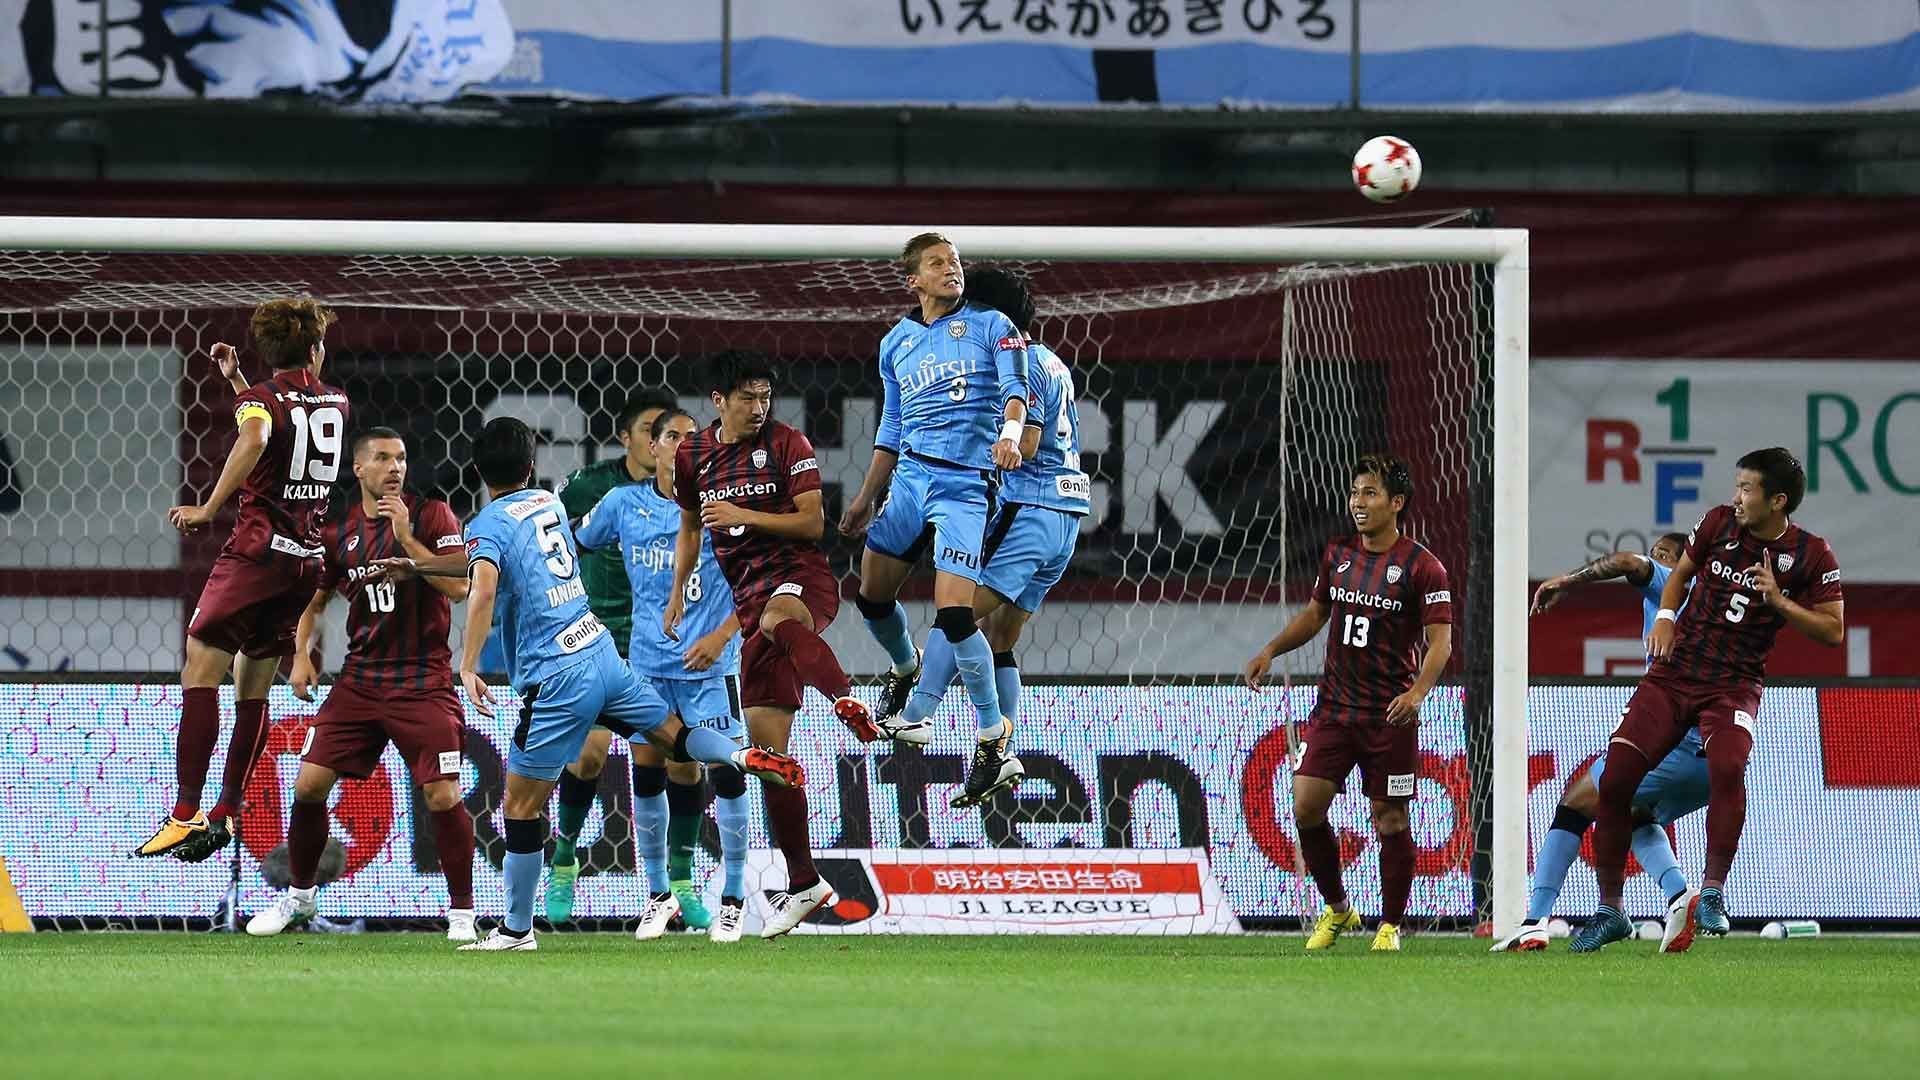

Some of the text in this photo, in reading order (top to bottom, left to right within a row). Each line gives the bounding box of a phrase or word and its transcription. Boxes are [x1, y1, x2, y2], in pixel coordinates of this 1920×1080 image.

[949, 377, 967, 402] 3
[290, 406, 344, 482] 19
[707, 483, 776, 501] Rakuten
[532, 510, 576, 580] 5
[942, 546, 978, 570] PFU
[365, 583, 395, 612] 10
[1337, 587, 1402, 612] Rakuten
[1726, 593, 1750, 623] 5
[1343, 614, 1370, 648] 13
[933, 869, 1143, 889] 明治安田生命
[958, 901, 1150, 914] J1 LEAGUE
